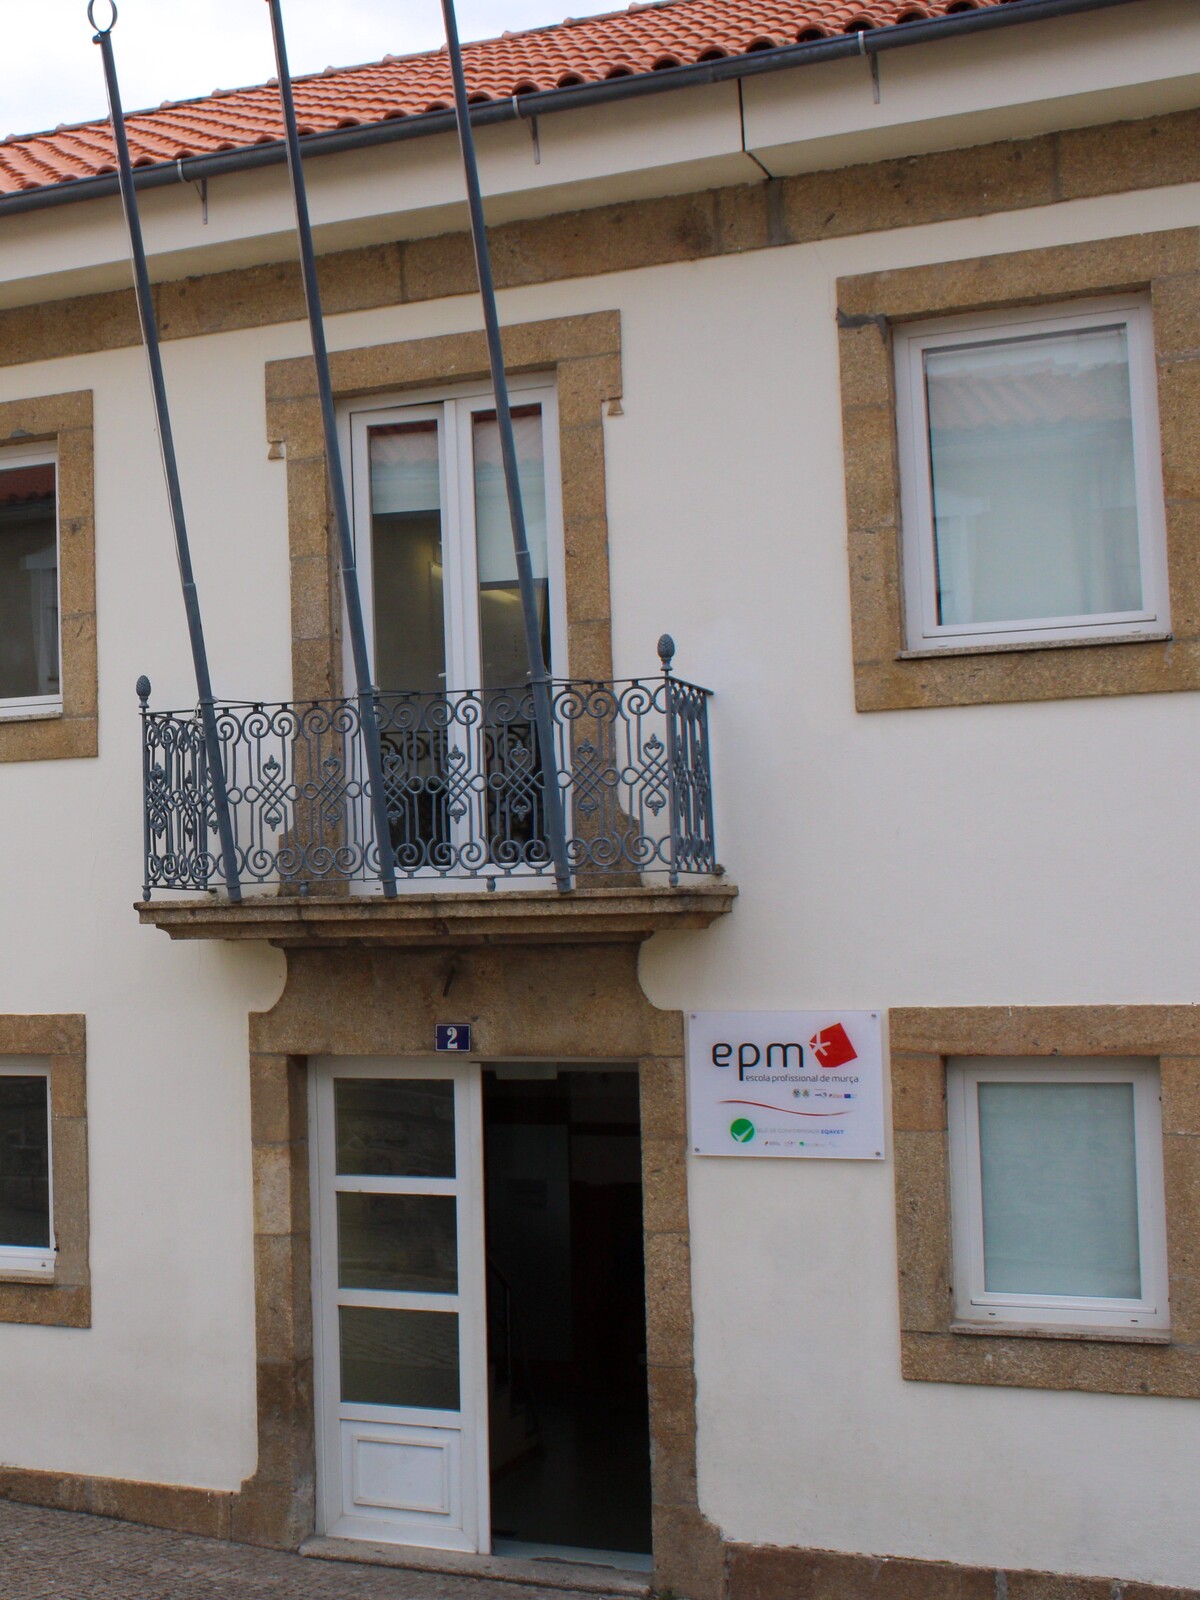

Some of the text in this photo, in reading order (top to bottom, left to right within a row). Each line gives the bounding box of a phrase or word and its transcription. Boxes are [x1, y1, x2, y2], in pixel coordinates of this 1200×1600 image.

[446, 1026, 458, 1049] 2
[711, 1042, 804, 1081] epm
[745, 1074, 859, 1084] escola profissional de murça
